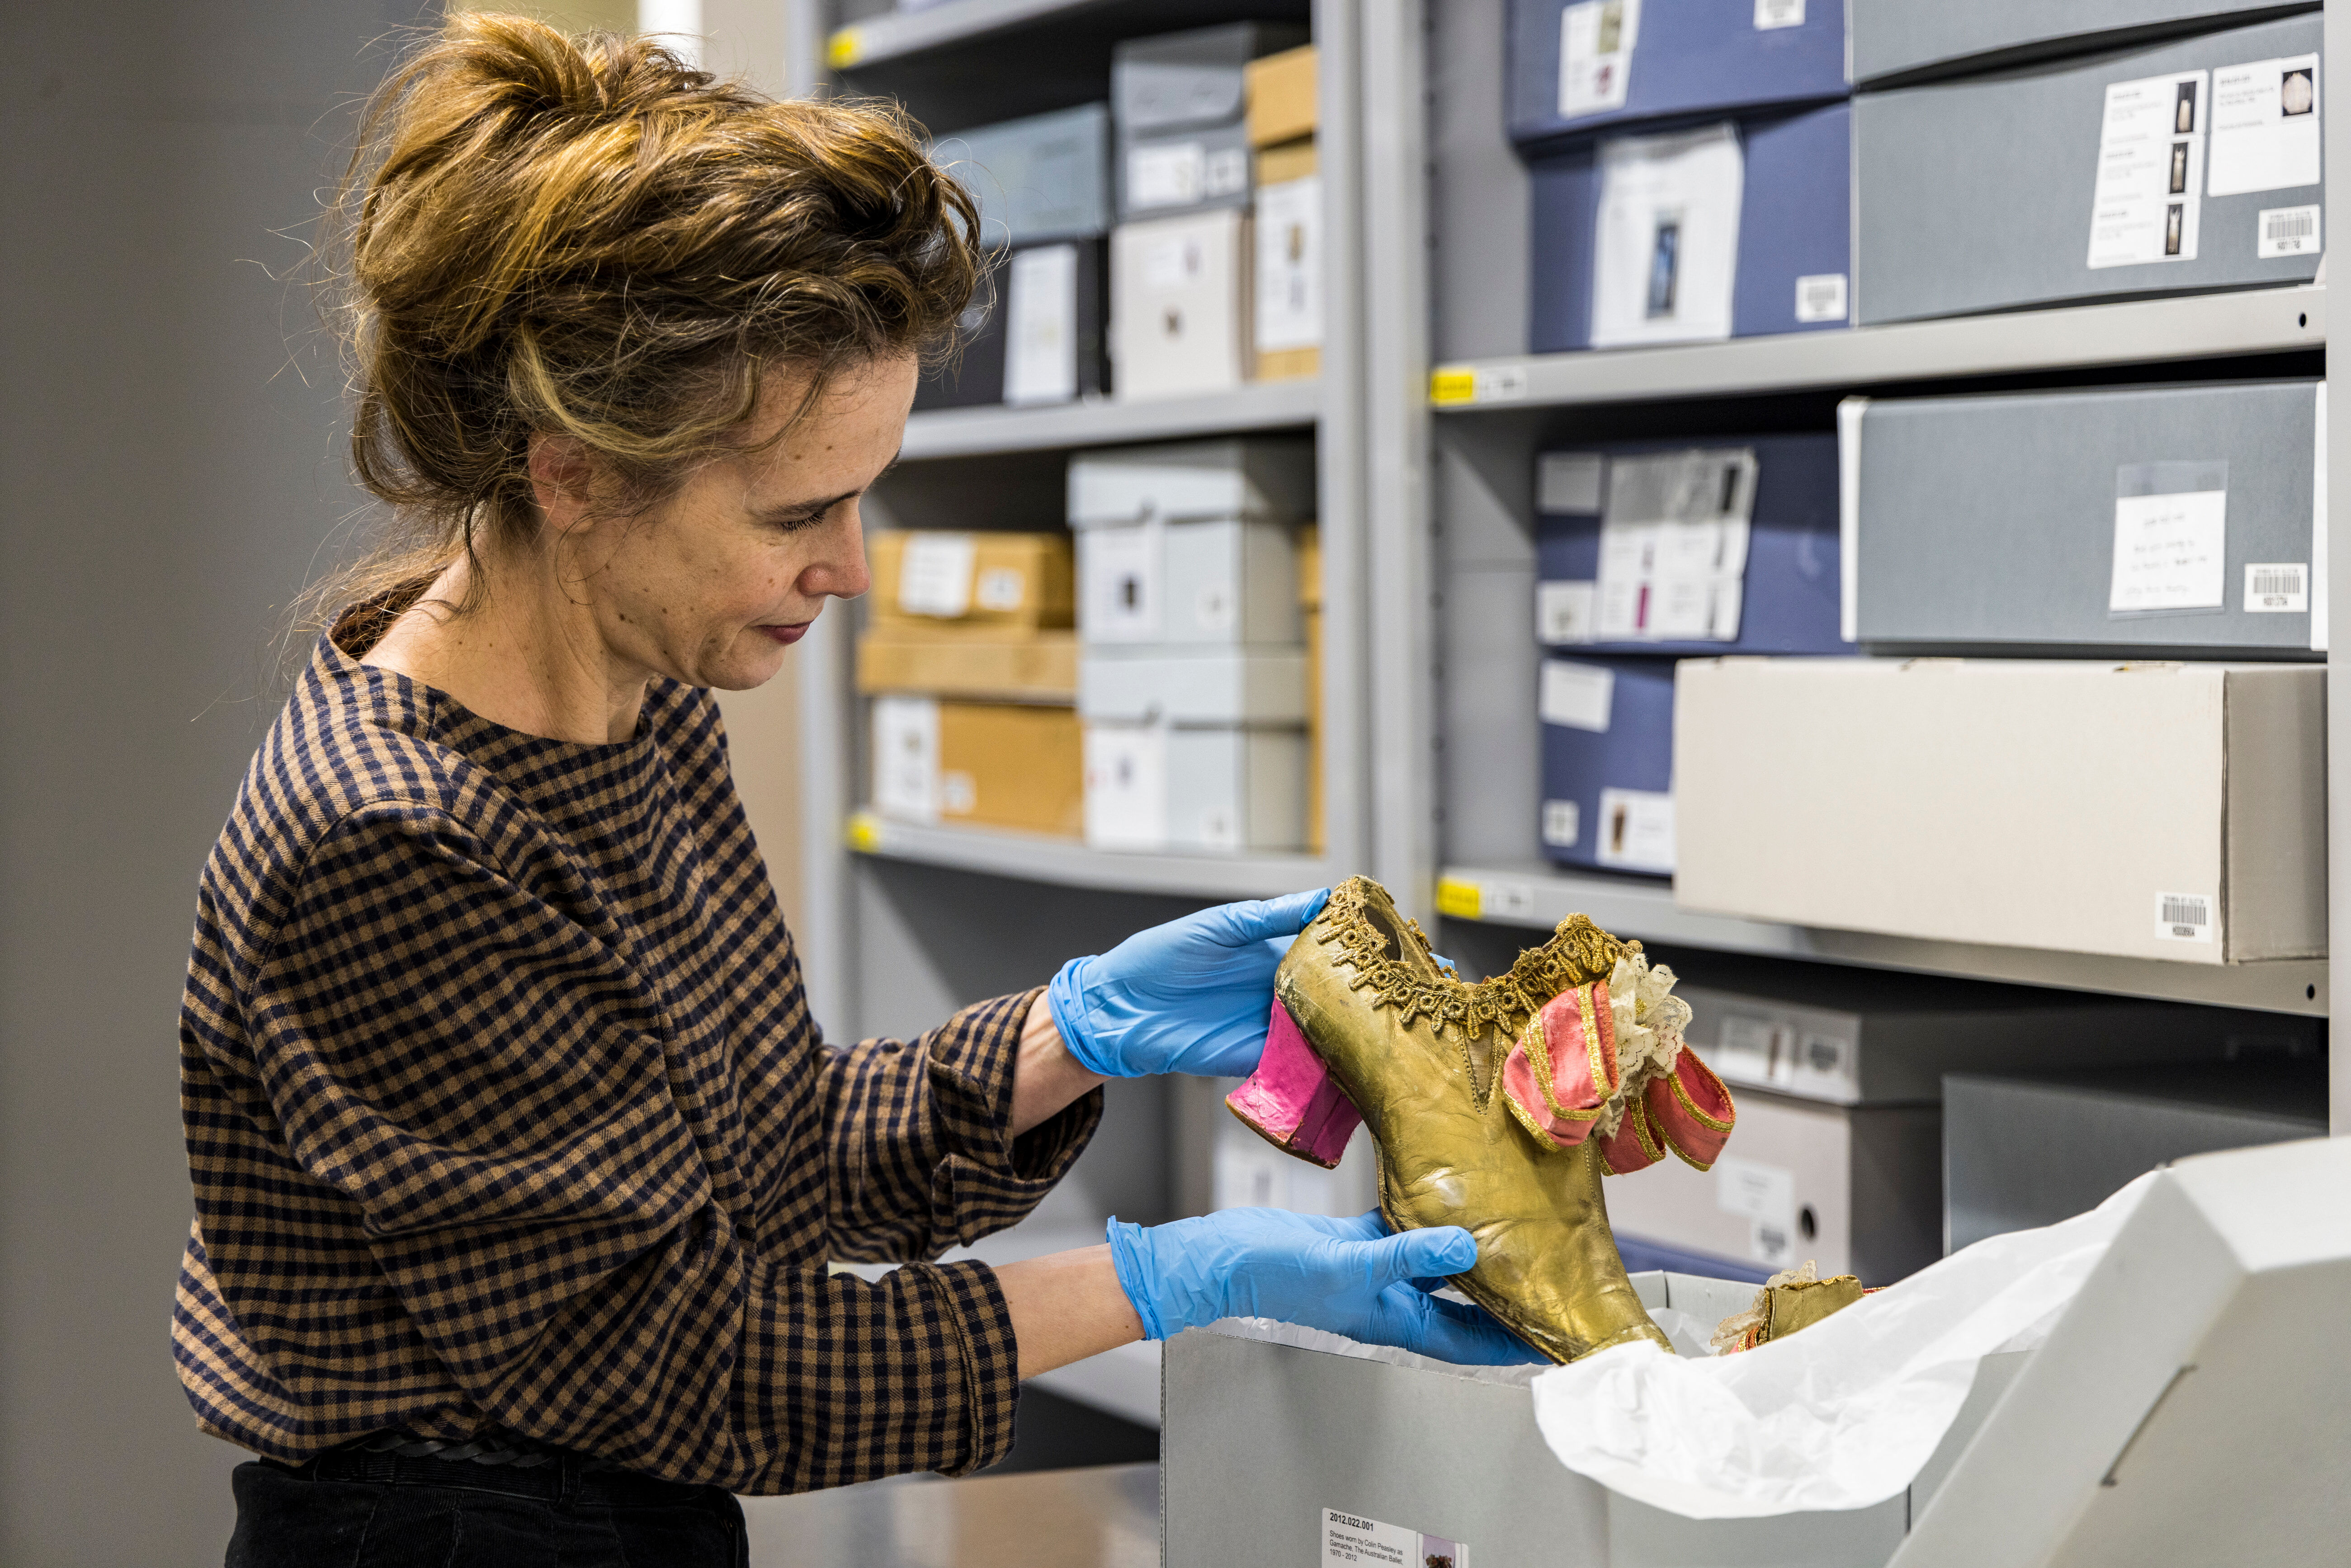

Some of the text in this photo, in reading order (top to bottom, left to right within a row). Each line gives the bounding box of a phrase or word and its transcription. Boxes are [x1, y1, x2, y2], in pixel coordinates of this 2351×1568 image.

[1330, 1513, 1374, 1531] 2012.022.001
[1330, 1530, 1344, 1540] Shoes
[1358, 1538, 1363, 1546] by
[1364, 1540, 1376, 1548] Colin
[1378, 1543, 1396, 1554] Peasley
[1330, 1540, 1353, 1552] Gamache,
[1364, 1549, 1388, 1560] Australian
[1330, 1549, 1341, 1557] 1970
[1345, 1553, 1357, 1561] 2012
